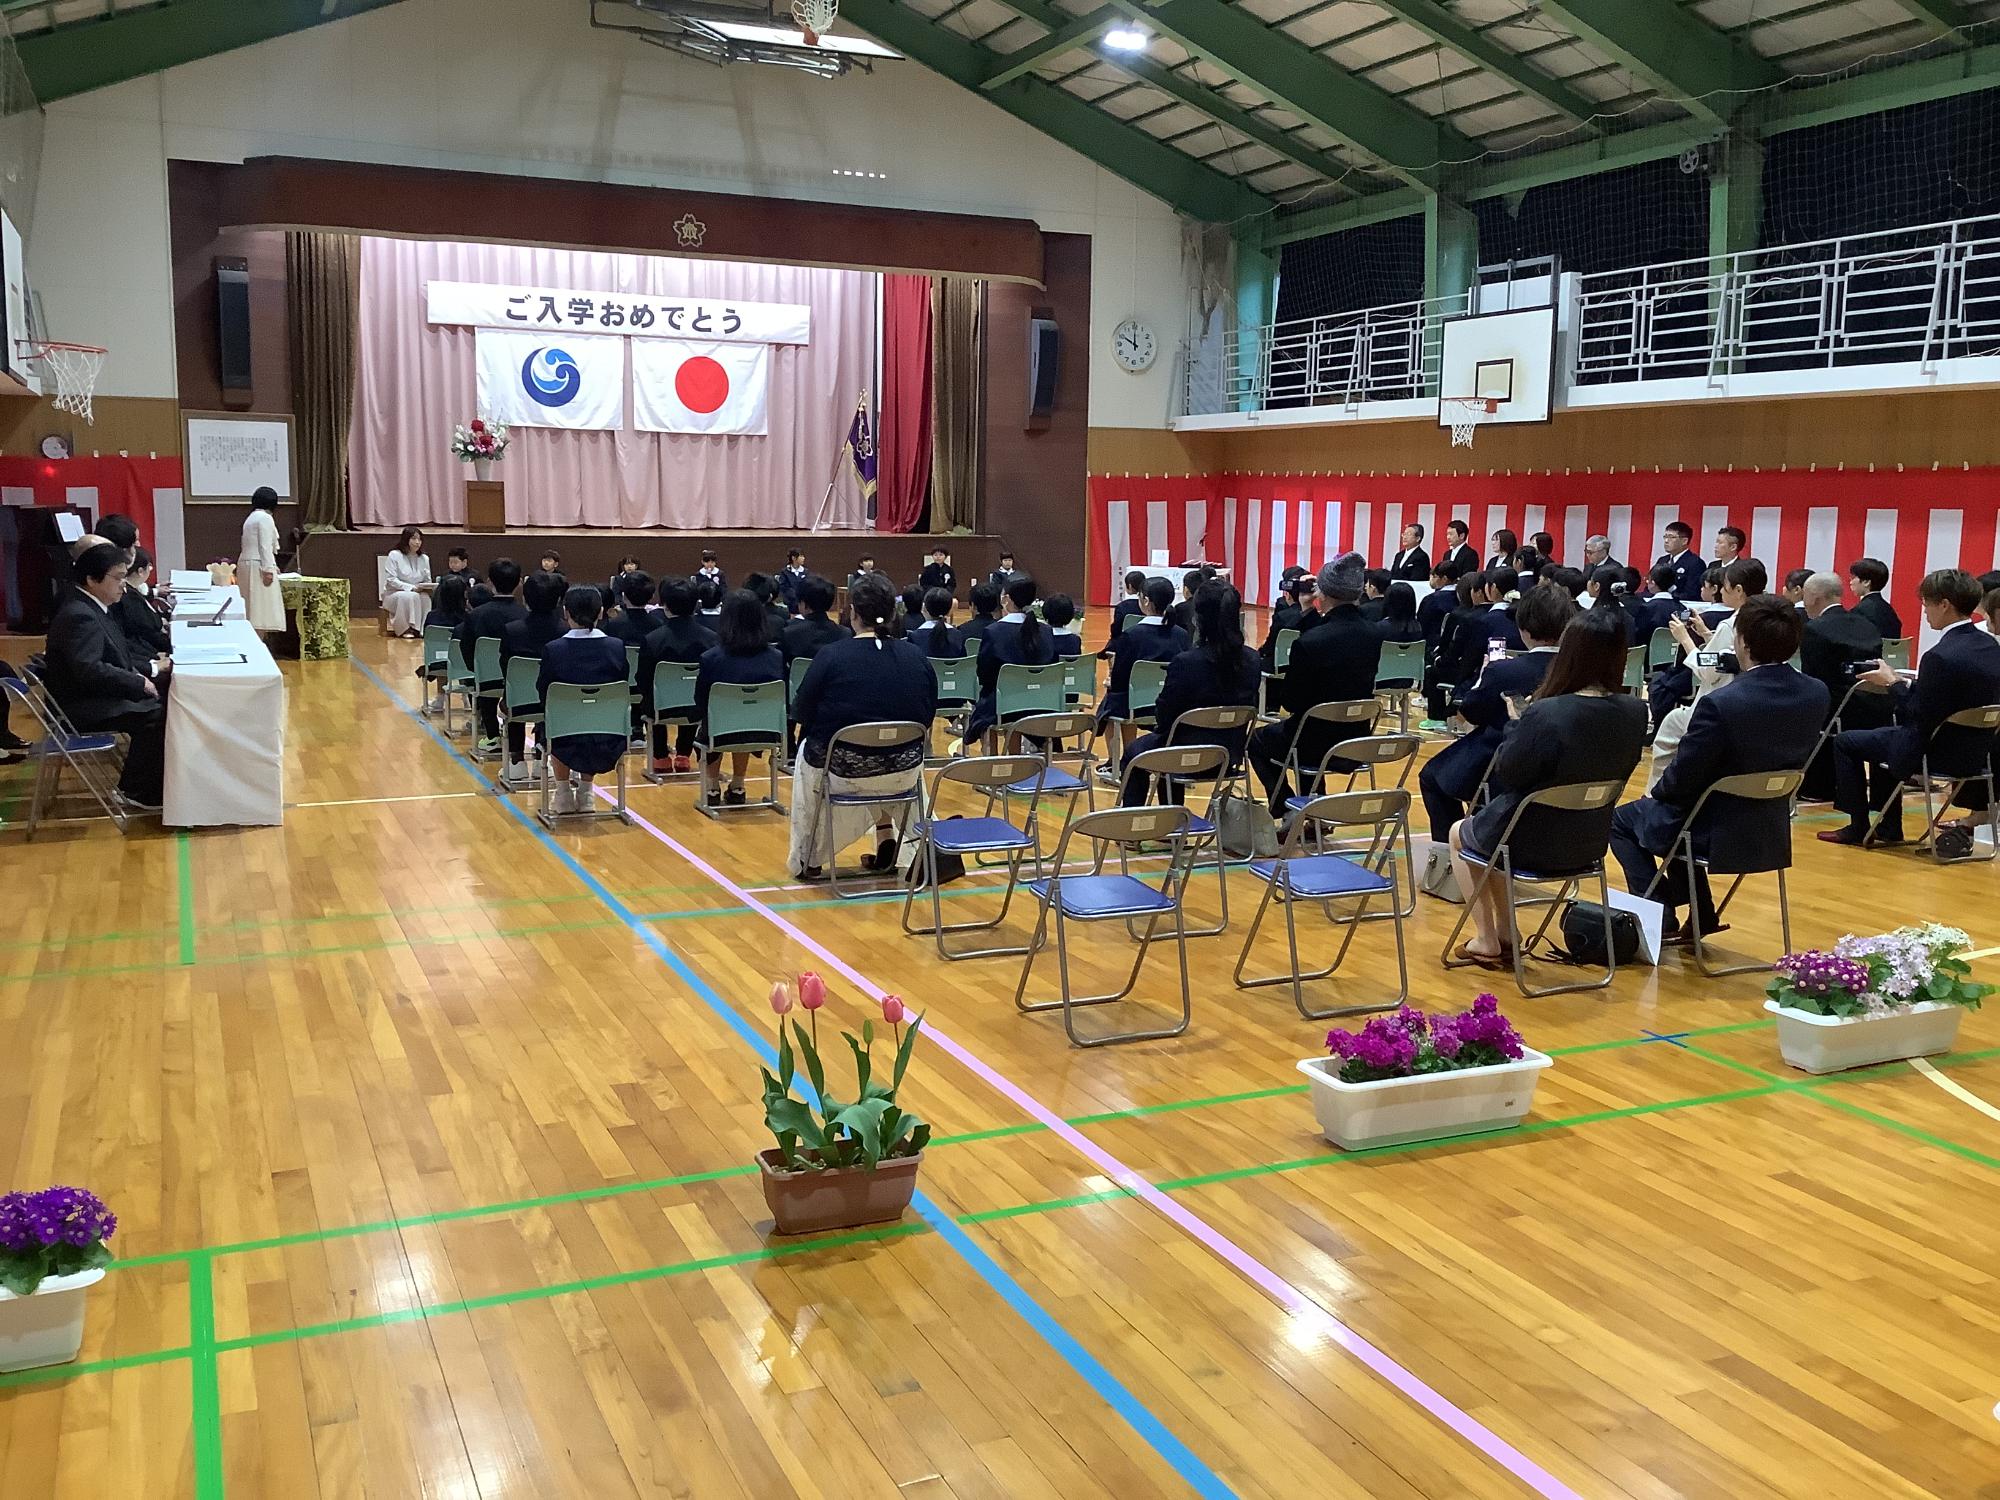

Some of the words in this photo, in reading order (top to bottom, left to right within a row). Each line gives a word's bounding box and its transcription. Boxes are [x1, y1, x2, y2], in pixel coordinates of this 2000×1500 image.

[505, 295, 742, 334] ご入学おめでとう
